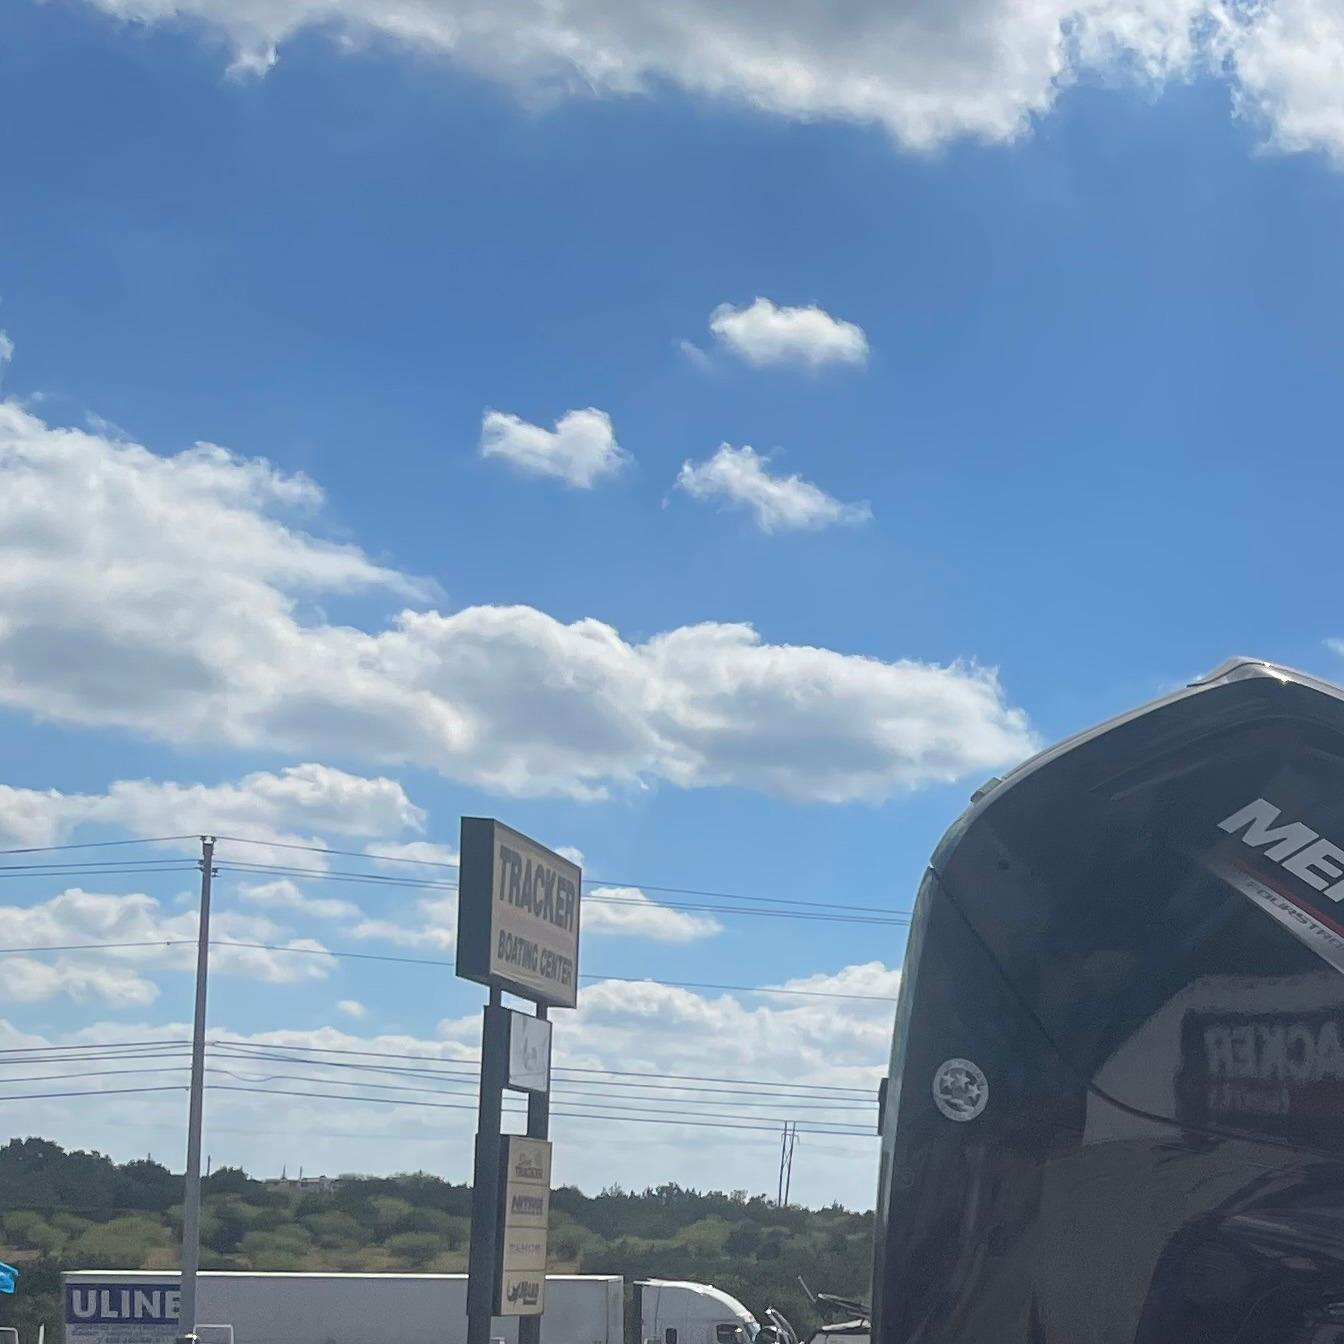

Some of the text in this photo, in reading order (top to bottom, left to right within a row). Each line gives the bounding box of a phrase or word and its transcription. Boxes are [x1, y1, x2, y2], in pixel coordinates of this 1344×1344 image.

[499, 845, 576, 933] TRACKER
[498, 930, 573, 985] BOATING CENTER
[72, 1289, 181, 1319] ULINE
